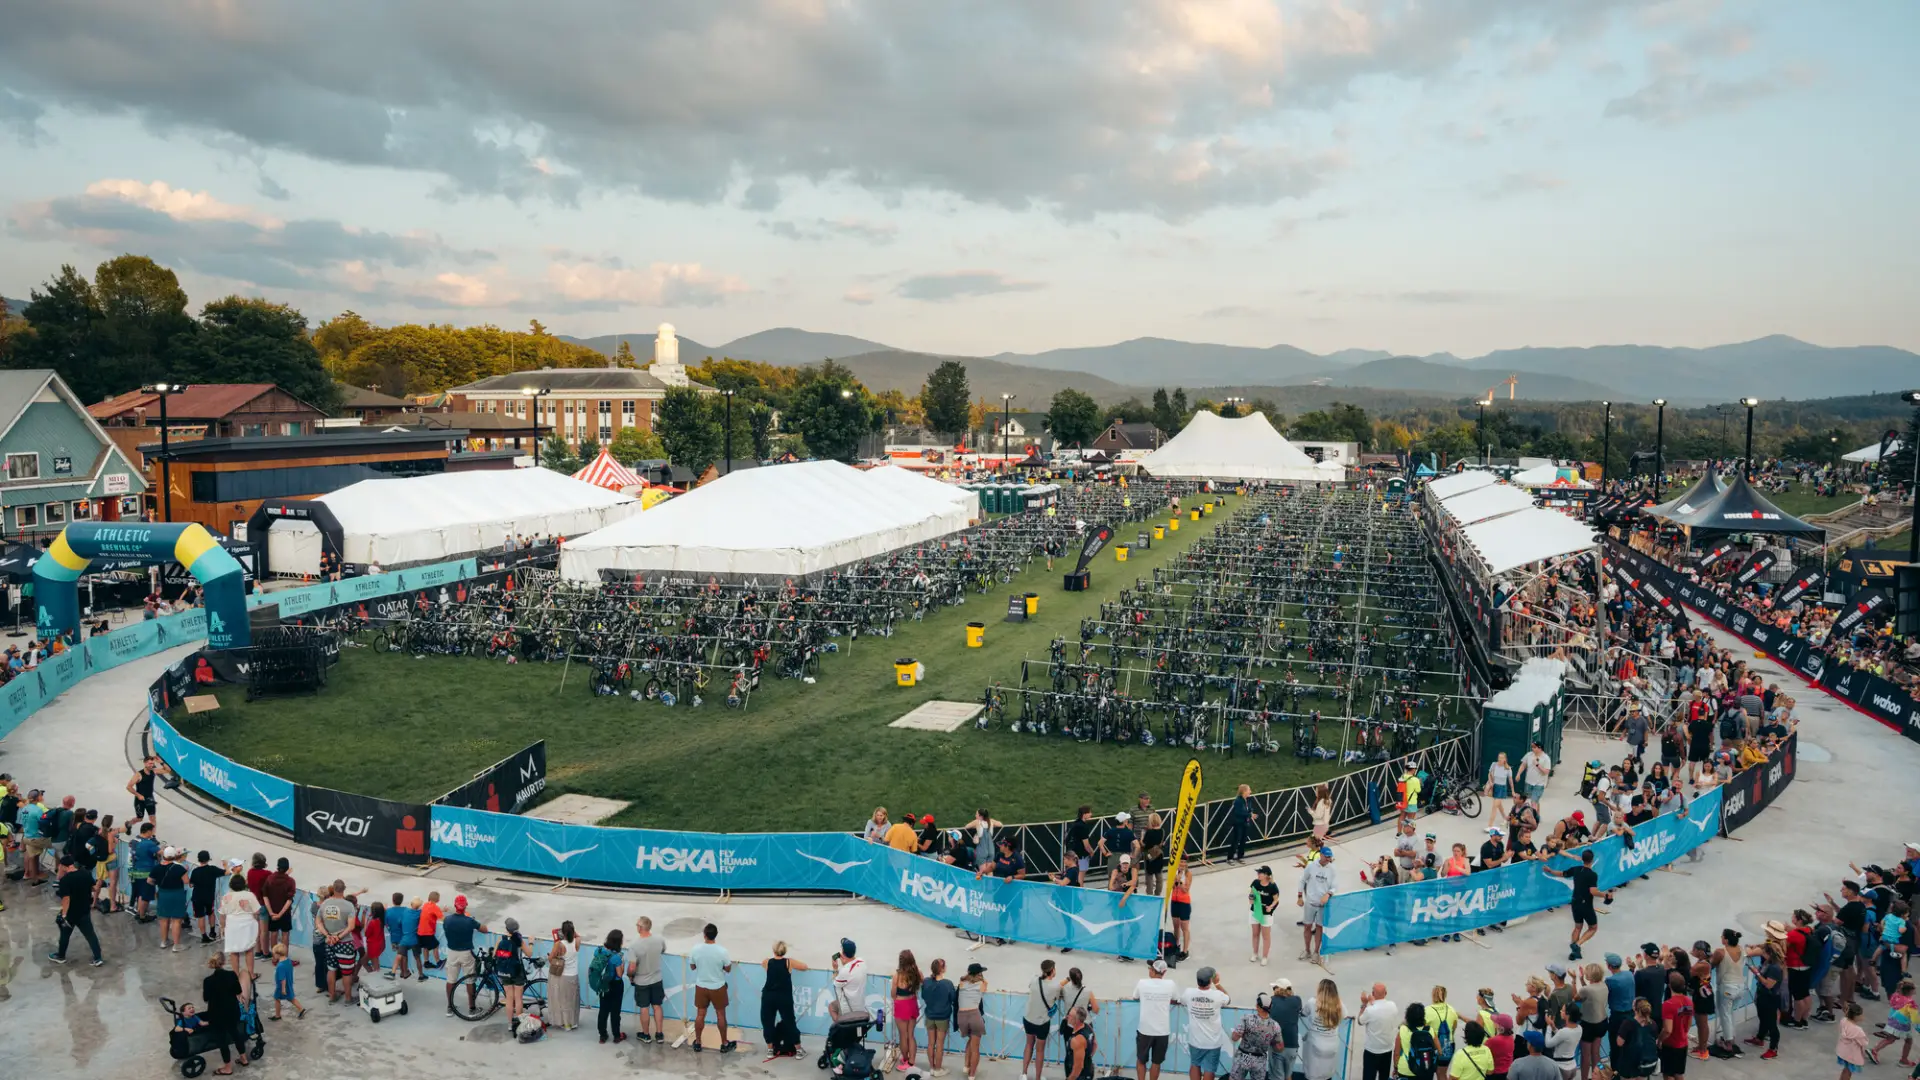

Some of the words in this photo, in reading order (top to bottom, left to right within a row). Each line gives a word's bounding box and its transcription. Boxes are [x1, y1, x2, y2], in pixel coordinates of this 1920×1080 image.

[1723, 509, 1781, 520] IRONMAN
[94, 528, 152, 542] ATHLETIC
[101, 543, 131, 552] BREWING
[1700, 544, 1732, 567] IRONMAN
[421, 569, 444, 580] ATHLETIC
[1738, 556, 1773, 583] IRONMAN
[355, 580, 380, 592] ATHLETIC
[1781, 572, 1821, 602] IRONMAN
[284, 592, 311, 606] ATHLETIC
[1643, 583, 1680, 617] IRONMAN
[377, 599, 409, 615] QATAR
[1839, 595, 1884, 630] IRONMAN
[109, 634, 138, 651] ATHLETIC
[1872, 694, 1901, 715] wahoo
[200, 758, 224, 789] HOKA
[1768, 760, 1782, 788] HOKA
[1724, 789, 1745, 819] HOKA
[465, 823, 478, 832] FLY
[1169, 794, 1194, 866] CROSSWALK
[465, 832, 496, 844] HUMAN
[465, 839, 478, 848] FLY
[636, 845, 718, 873] HOKA
[719, 849, 735, 858] FLY
[1619, 833, 1660, 873] HOKA
[719, 857, 757, 866] HUMAN
[719, 865, 735, 873] FLY
[900, 868, 969, 913] HOKA
[969, 889, 984, 899] FLY
[1487, 883, 1500, 893] FLY
[1487, 887, 1516, 900] HUMAN
[969, 898, 1007, 913] HUMAN
[1410, 887, 1486, 924] HOKA
[1486, 899, 1499, 910] FLY
[969, 907, 984, 917] FLY
